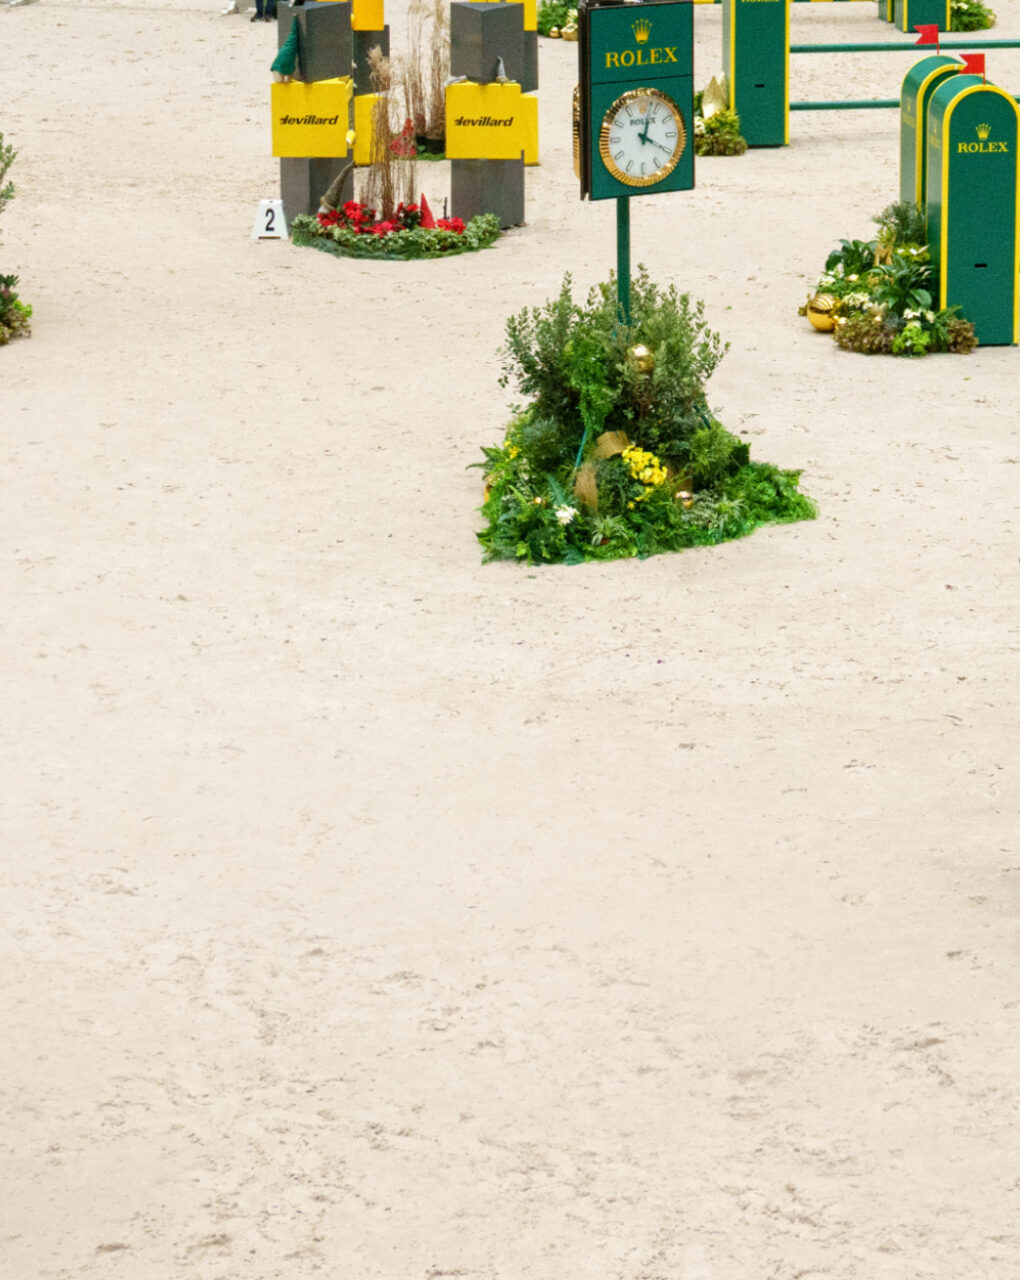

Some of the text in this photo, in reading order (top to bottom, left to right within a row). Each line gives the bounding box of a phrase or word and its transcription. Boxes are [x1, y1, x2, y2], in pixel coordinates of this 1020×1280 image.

[605, 46, 678, 69] ROLEX
[280, 114, 339, 126] devillard
[454, 115, 514, 127] devillard
[630, 117, 656, 126] ROLX
[957, 141, 1009, 153] ROLEX
[265, 208, 275, 232] 2
